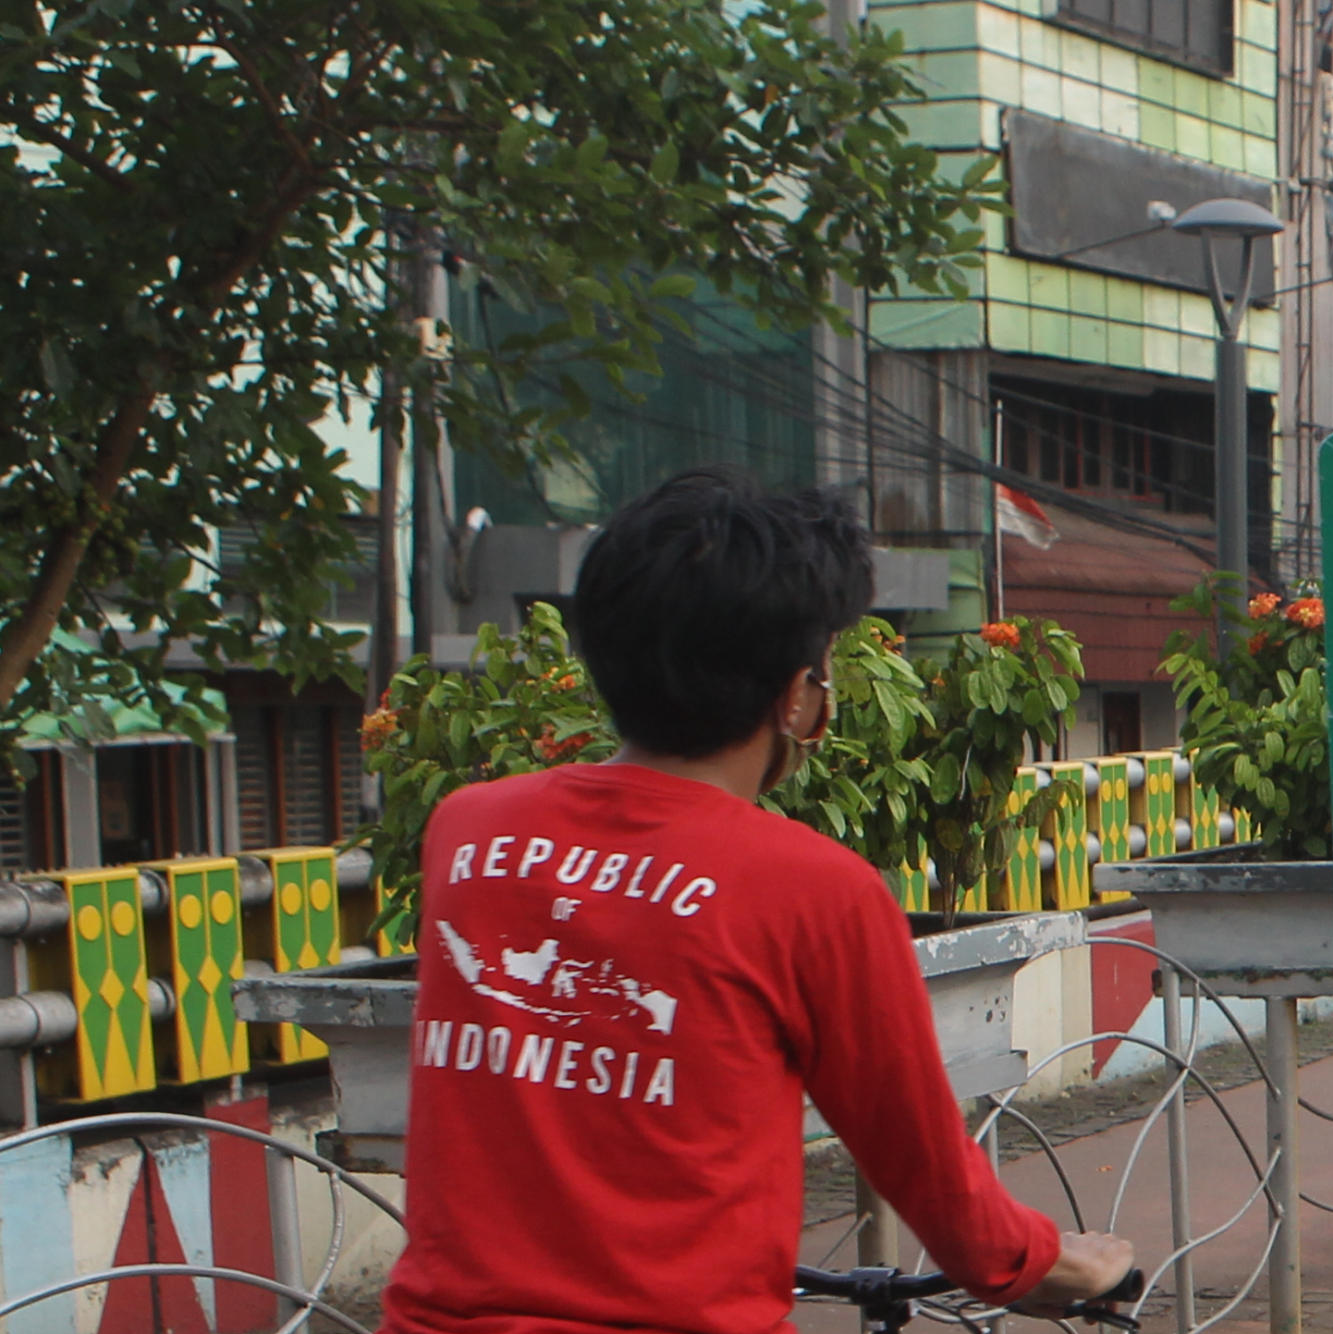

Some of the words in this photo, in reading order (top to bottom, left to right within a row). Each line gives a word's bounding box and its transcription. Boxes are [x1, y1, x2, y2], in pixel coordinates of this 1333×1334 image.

[448, 836, 717, 917] REPUBLIC
[551, 896, 582, 921] OF
[415, 1020, 676, 1106] INDONESIA
